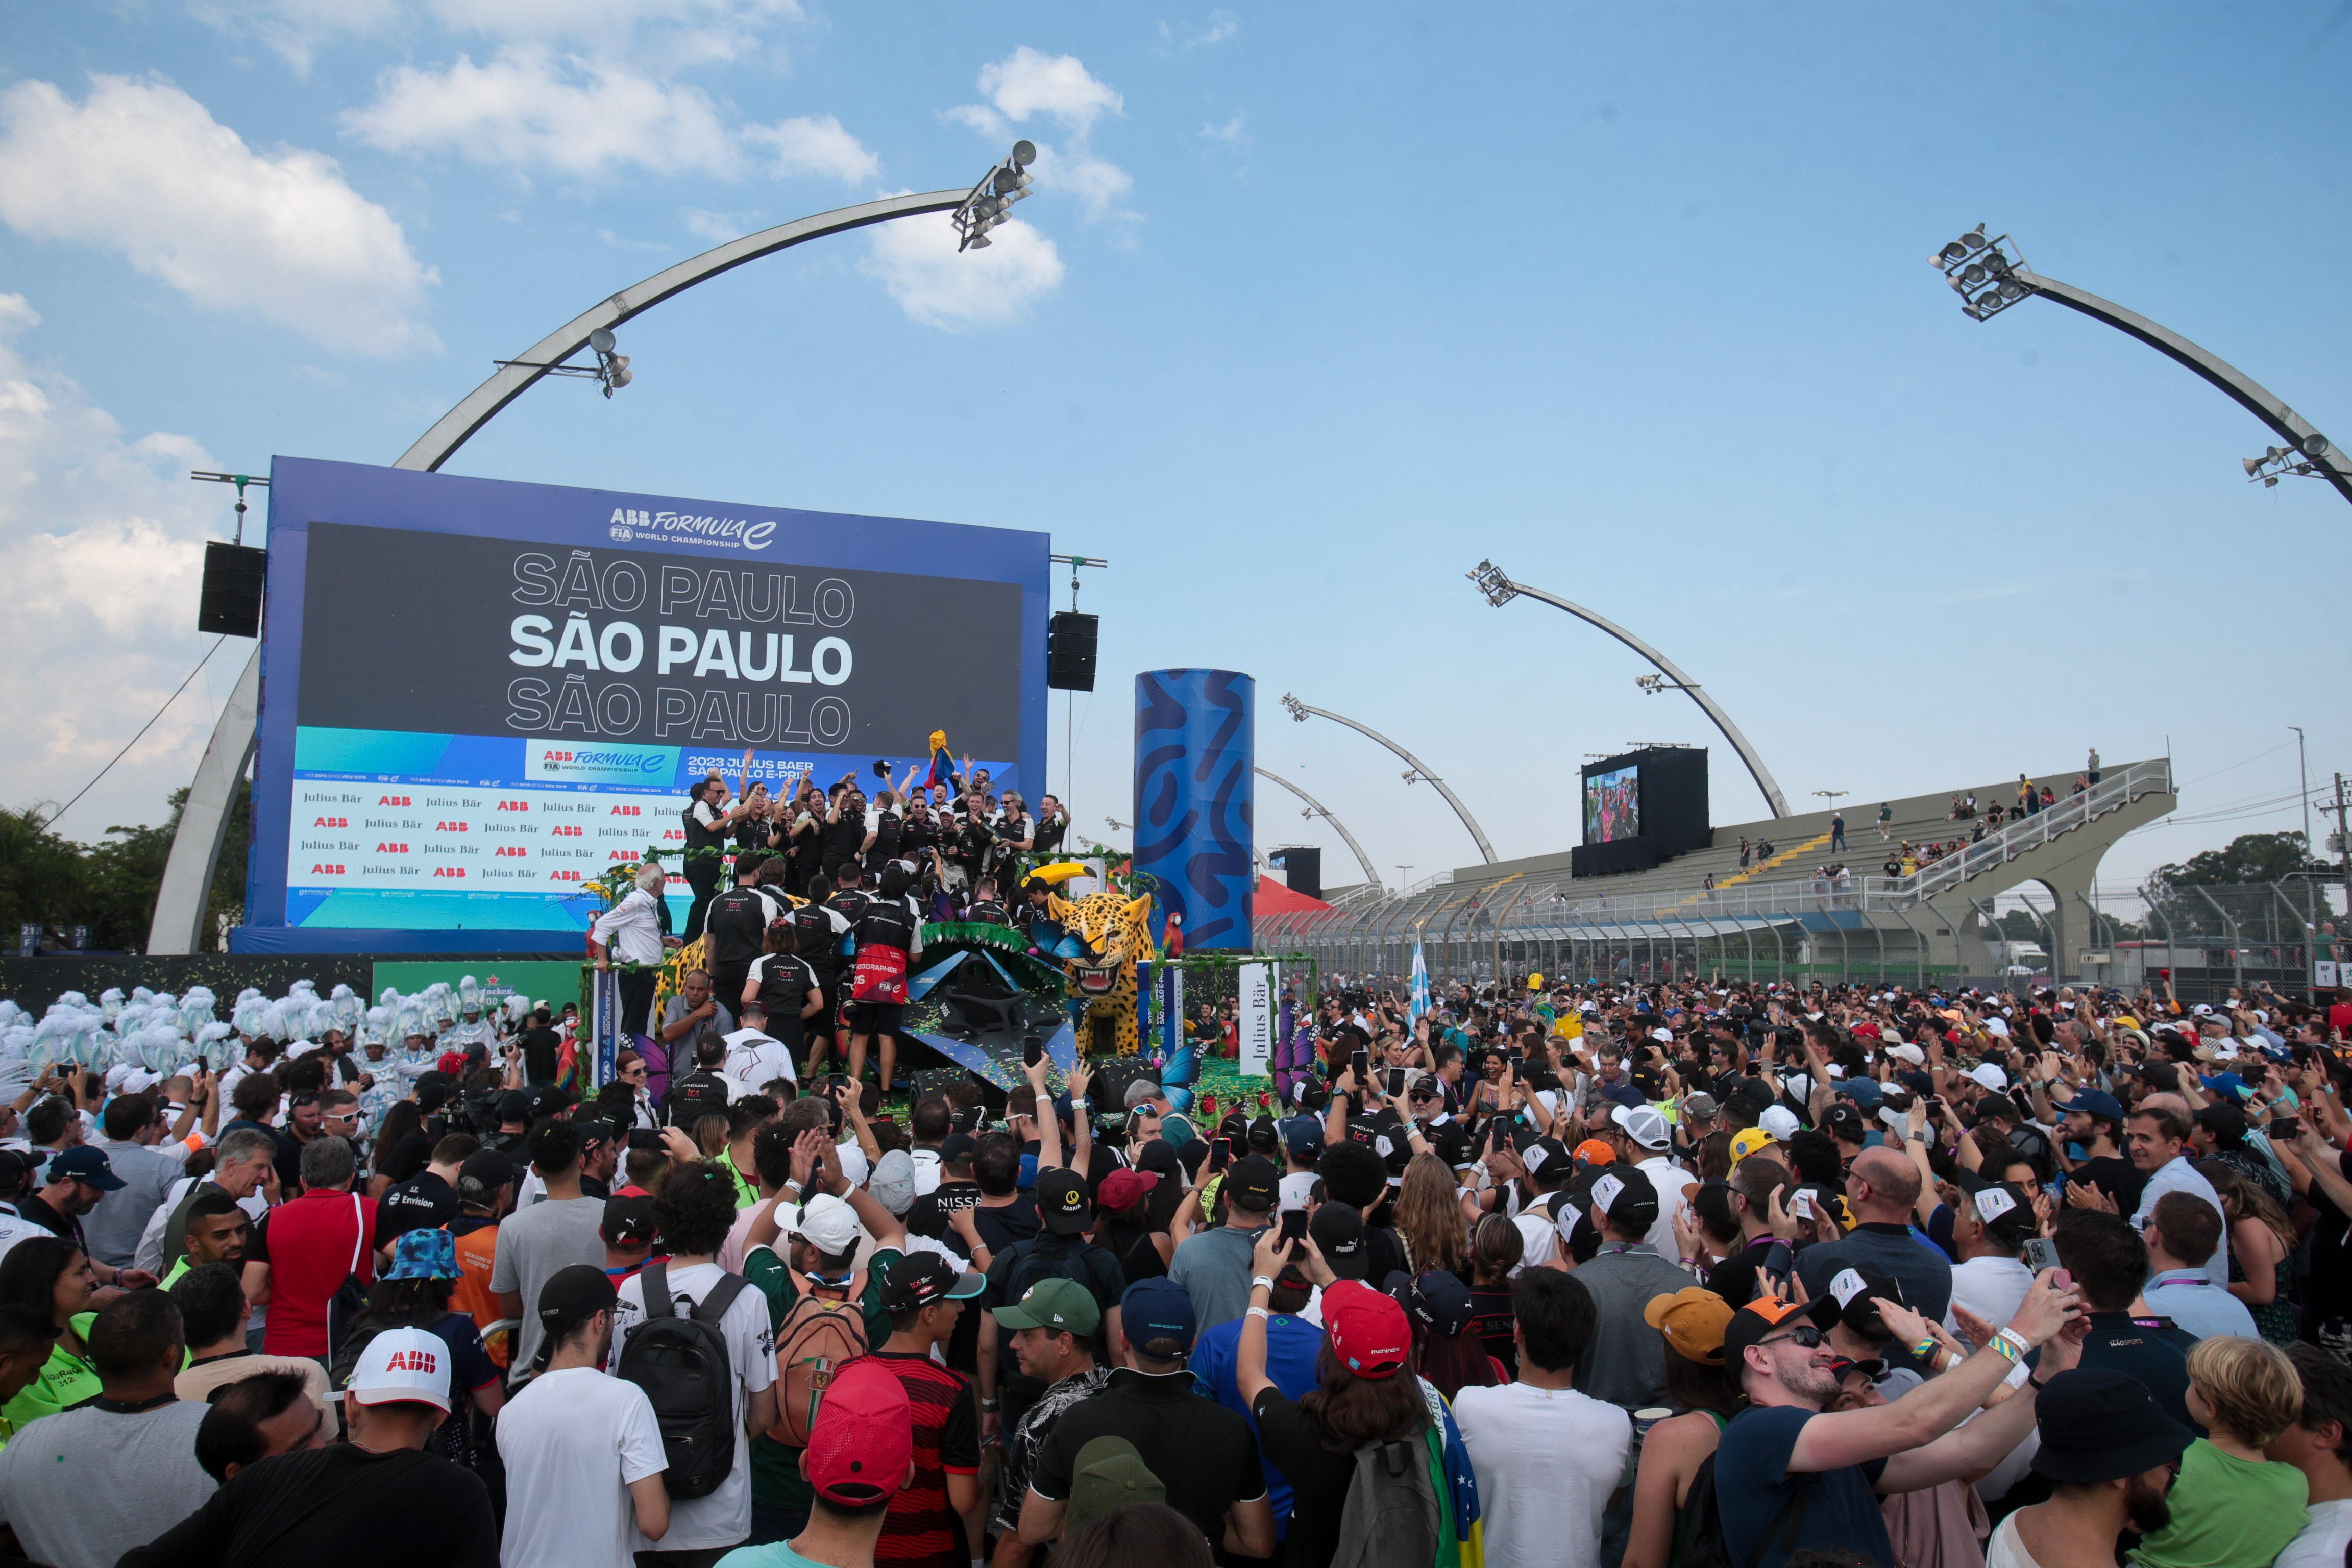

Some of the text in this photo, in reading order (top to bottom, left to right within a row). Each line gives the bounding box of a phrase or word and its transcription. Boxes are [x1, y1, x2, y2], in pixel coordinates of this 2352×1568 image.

[610, 508, 650, 527] ABB
[652, 511, 747, 538] FORMULA
[610, 526, 740, 548] FIA WORLD CHAMPIONSHIP
[512, 550, 854, 628] SÃO PAULO
[509, 611, 852, 686] SÃO PAULO
[506, 674, 850, 746] SÃO PAULO
[544, 751, 572, 762] ABB
[574, 752, 641, 767] FORMULA
[688, 756, 814, 771] 2023 BAER
[543, 762, 560, 771] FIA
[304, 793, 363, 803] Julius Bär
[378, 796, 411, 806] ABB
[426, 798, 482, 808] Julius Bär
[497, 801, 529, 812] ABB
[543, 802, 597, 813] Julius Bär
[611, 805, 641, 816] ABB
[314, 817, 348, 828] ABB
[365, 819, 423, 829] Julius Bär
[435, 821, 468, 832] ABB
[484, 823, 540, 833] Julius Bär
[551, 825, 583, 836] ABB
[598, 827, 651, 837] Julius Bär
[301, 840, 360, 851] Julius Bär
[376, 843, 409, 853] ABB
[424, 844, 480, 854] Julius Bär
[495, 847, 527, 857] ABB
[541, 848, 595, 859] Julius Bär
[609, 850, 639, 861] ABB
[311, 864, 345, 874] ABB
[363, 866, 420, 875] Julius Bär
[433, 867, 466, 878] ABB
[482, 869, 537, 878] Julius Bär
[550, 871, 581, 881] ABB
[22, 926, 35, 935] 21
[879, 982, 892, 991] FIA
[940, 1002, 950, 1017] BOSS
[1253, 980, 1268, 1059] Julius Bär
[687, 1088, 700, 1097] tcs
[1349, 1123, 1374, 1133] JAGUA
[1353, 1130, 1368, 1142] tcs
[402, 1196, 433, 1208] Envision
[938, 1197, 982, 1208] NISSA
[464, 1251, 485, 1262] SEASON
[910, 1280, 921, 1289] tcs
[1415, 1307, 1434, 1322] telcel
[386, 1351, 435, 1374] ABB
